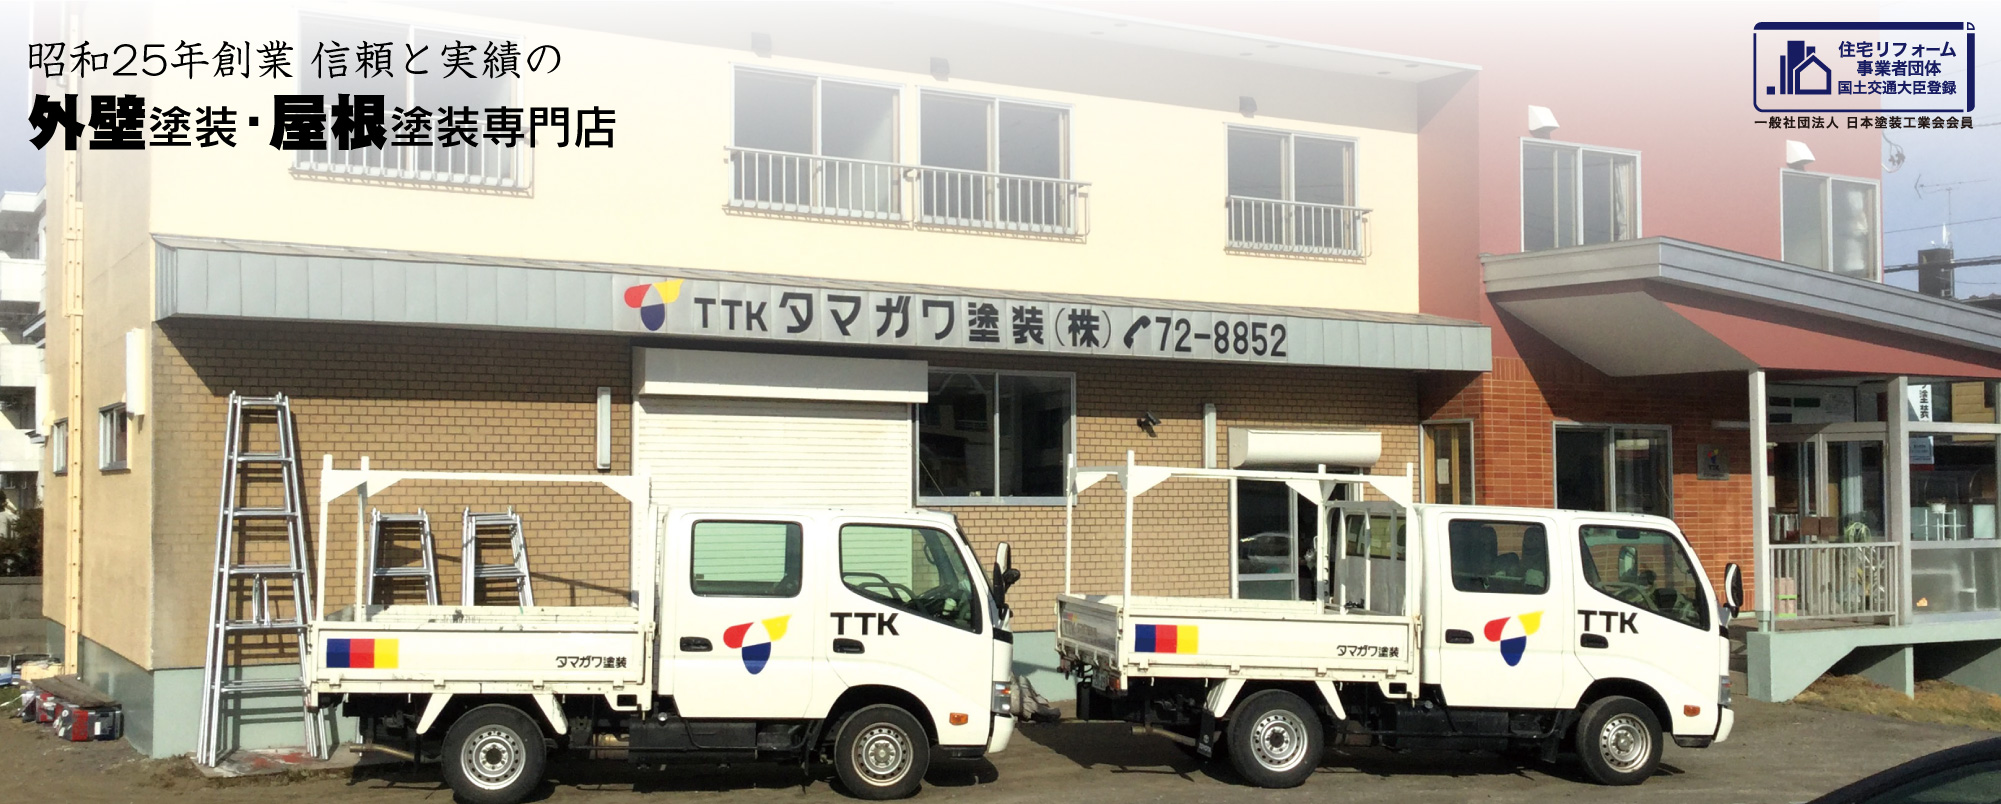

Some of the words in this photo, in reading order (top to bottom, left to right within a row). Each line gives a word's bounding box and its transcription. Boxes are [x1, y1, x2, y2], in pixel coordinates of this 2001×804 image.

[694, 297, 768, 332] TTK
[1155, 316, 1287, 357] 72-8852
[1919, 385, 1930, 419] 塗装
[830, 612, 900, 636] TTK
[1577, 609, 1639, 634] TTK
[555, 655, 627, 668] タマガワ塗装
[1336, 645, 1399, 658] タマガワ塗装
